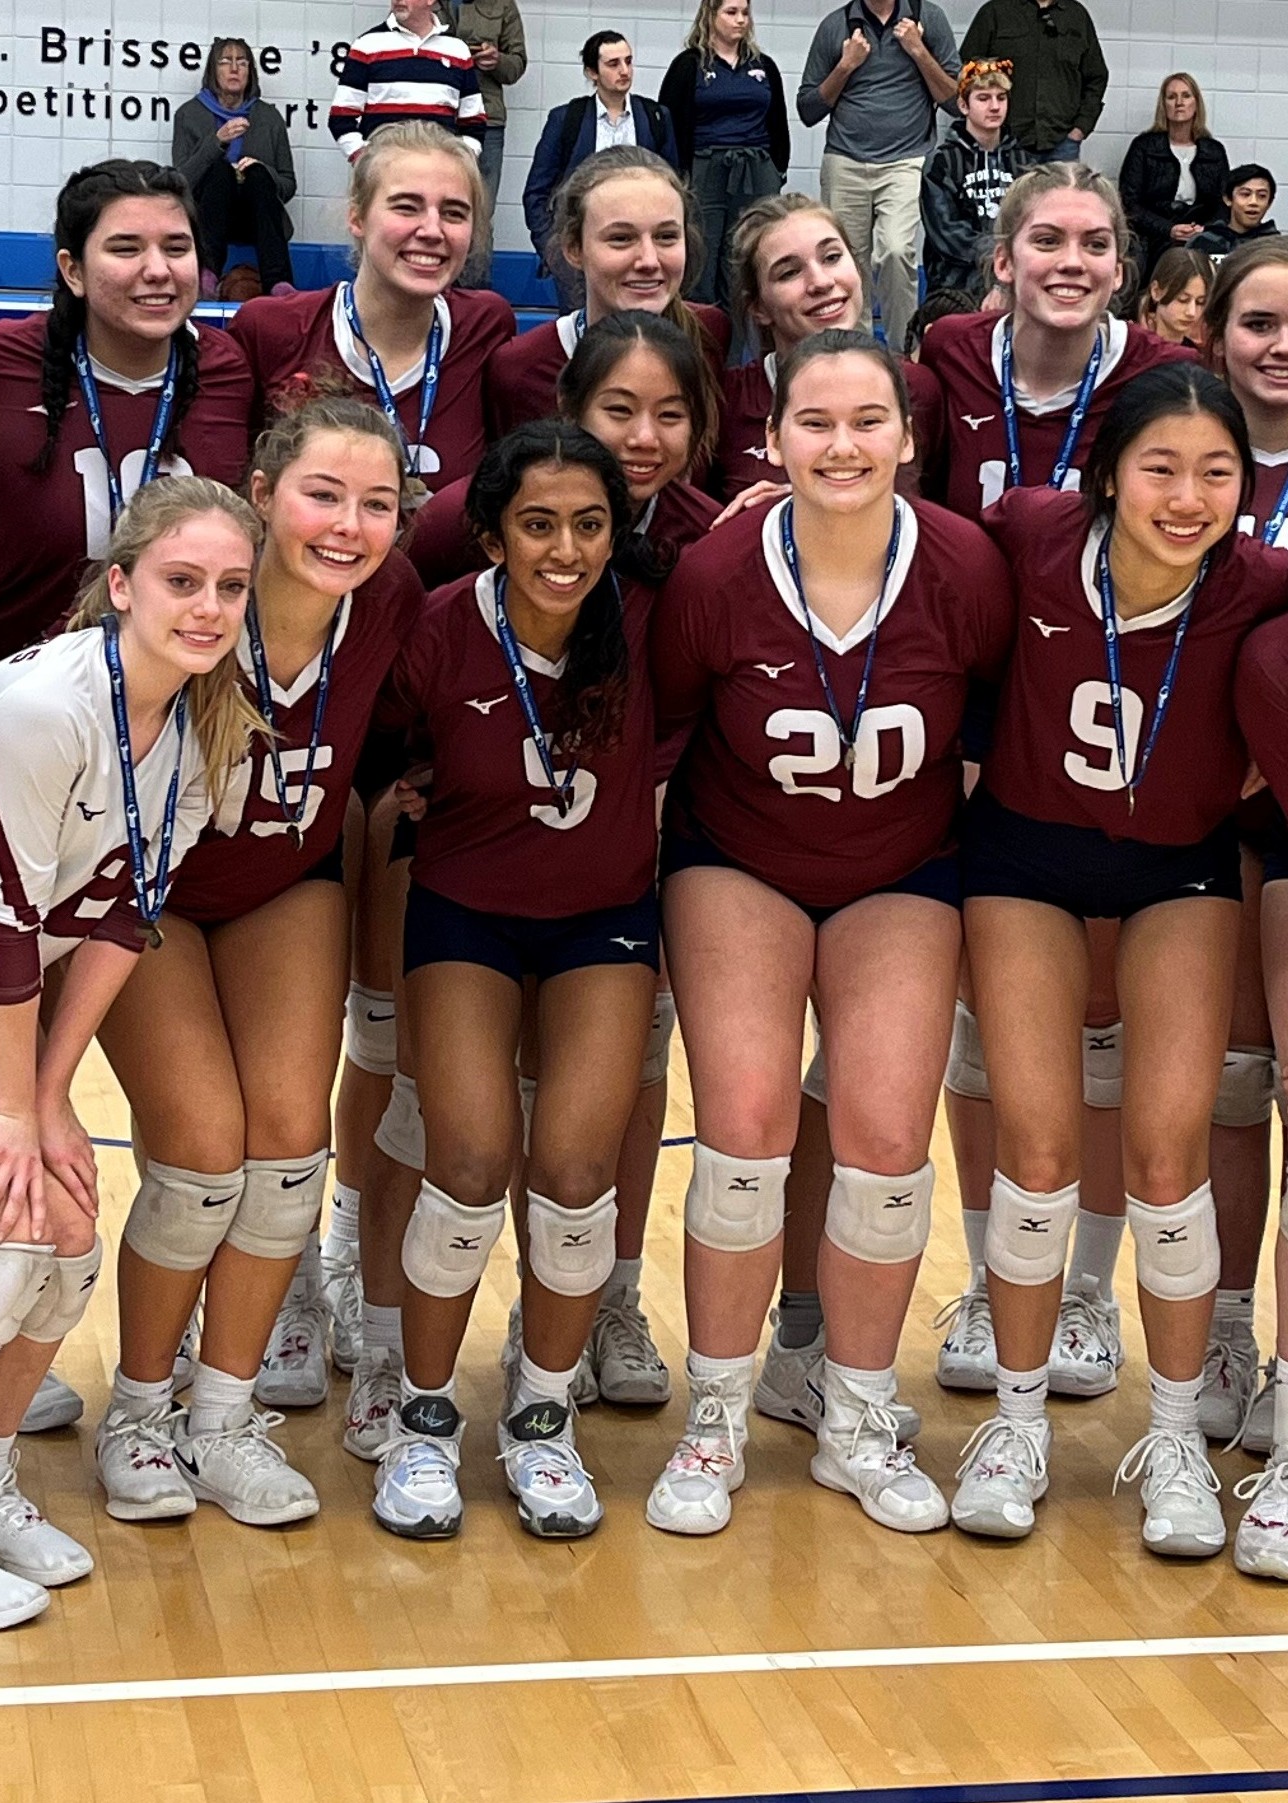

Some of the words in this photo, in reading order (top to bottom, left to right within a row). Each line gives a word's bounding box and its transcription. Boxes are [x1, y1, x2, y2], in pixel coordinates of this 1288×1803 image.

[40, 27, 282, 76] Brissee
[311, 40, 351, 78] '8
[523, 732, 598, 830] 5
[765, 703, 926, 802] 20
[1064, 680, 1144, 791] 9
